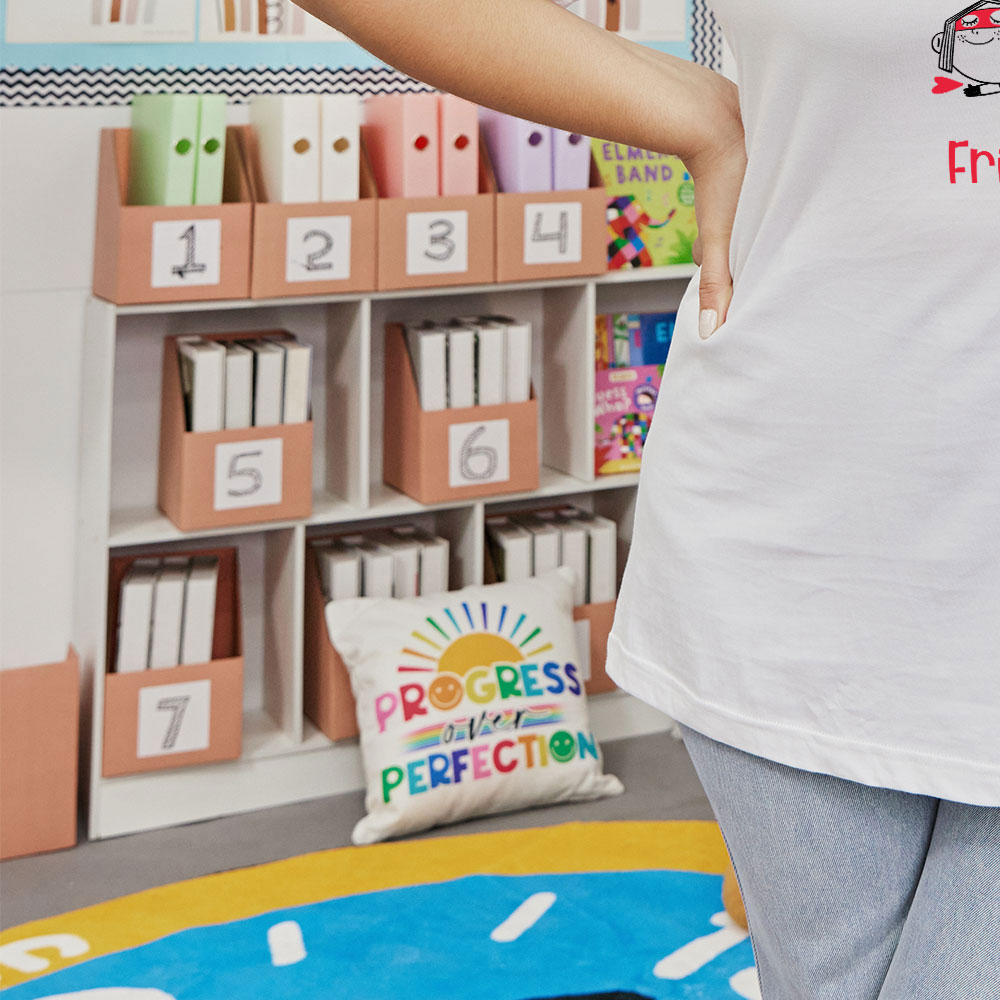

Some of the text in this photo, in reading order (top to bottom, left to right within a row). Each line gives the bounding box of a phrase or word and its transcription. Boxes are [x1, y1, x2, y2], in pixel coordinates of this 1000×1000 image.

[616, 165, 673, 184] BAND
[171, 224, 208, 279] 1
[303, 229, 334, 271] 2
[423, 219, 455, 262] 3
[530, 211, 569, 254] 4
[227, 449, 263, 497] 5
[459, 426, 499, 481] 6
[374, 662, 582, 733] PROGRESS
[155, 695, 191, 750] 7
[443, 708, 528, 744] over
[382, 730, 599, 804] PERFECTION
